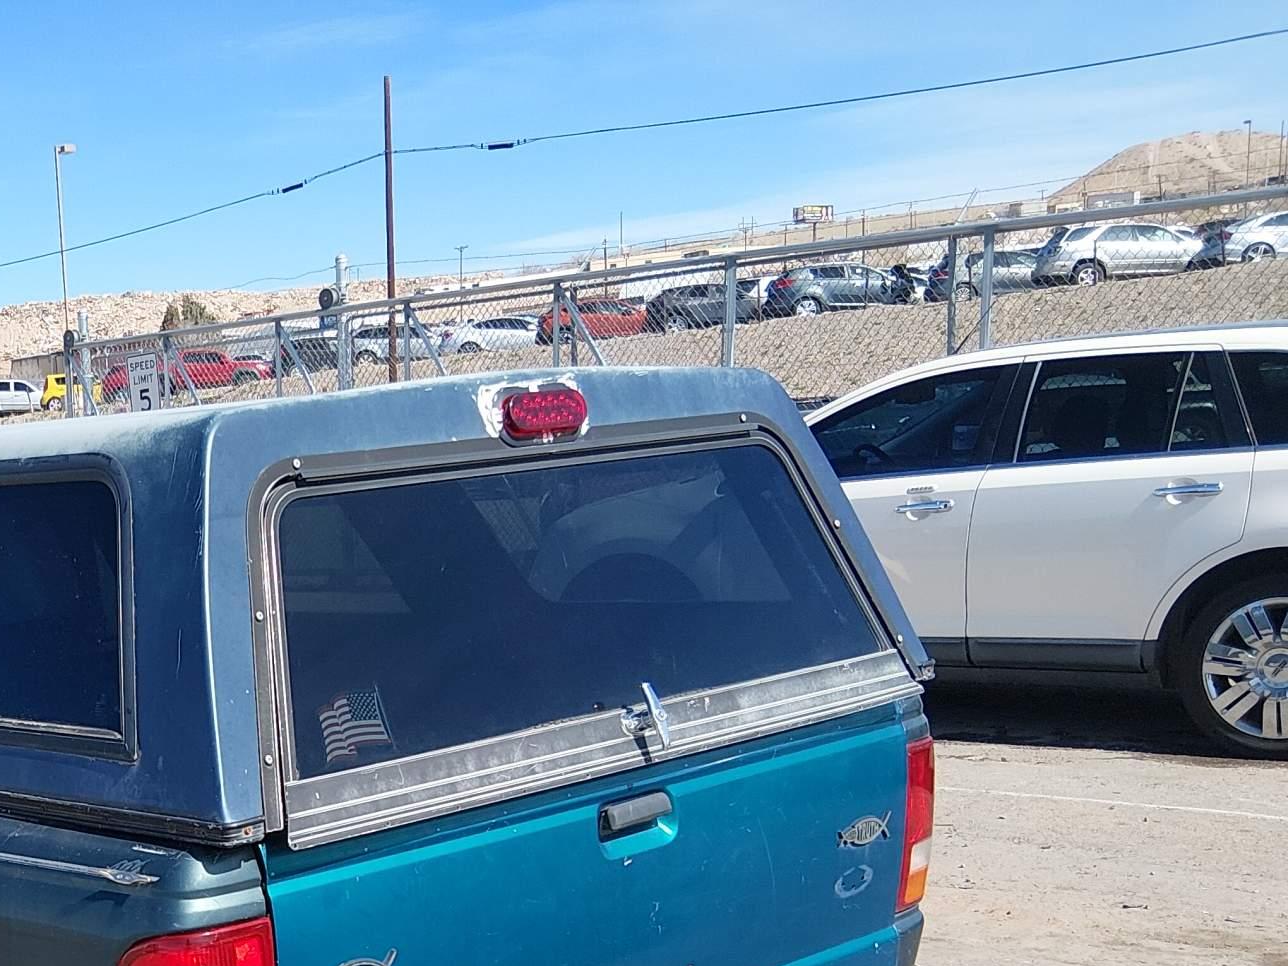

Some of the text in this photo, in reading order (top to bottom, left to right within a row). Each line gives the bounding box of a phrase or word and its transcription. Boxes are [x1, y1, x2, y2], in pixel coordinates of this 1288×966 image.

[130, 360, 154, 372] SPEED
[134, 374, 153, 385] LIMIT
[140, 389, 152, 411] 5
